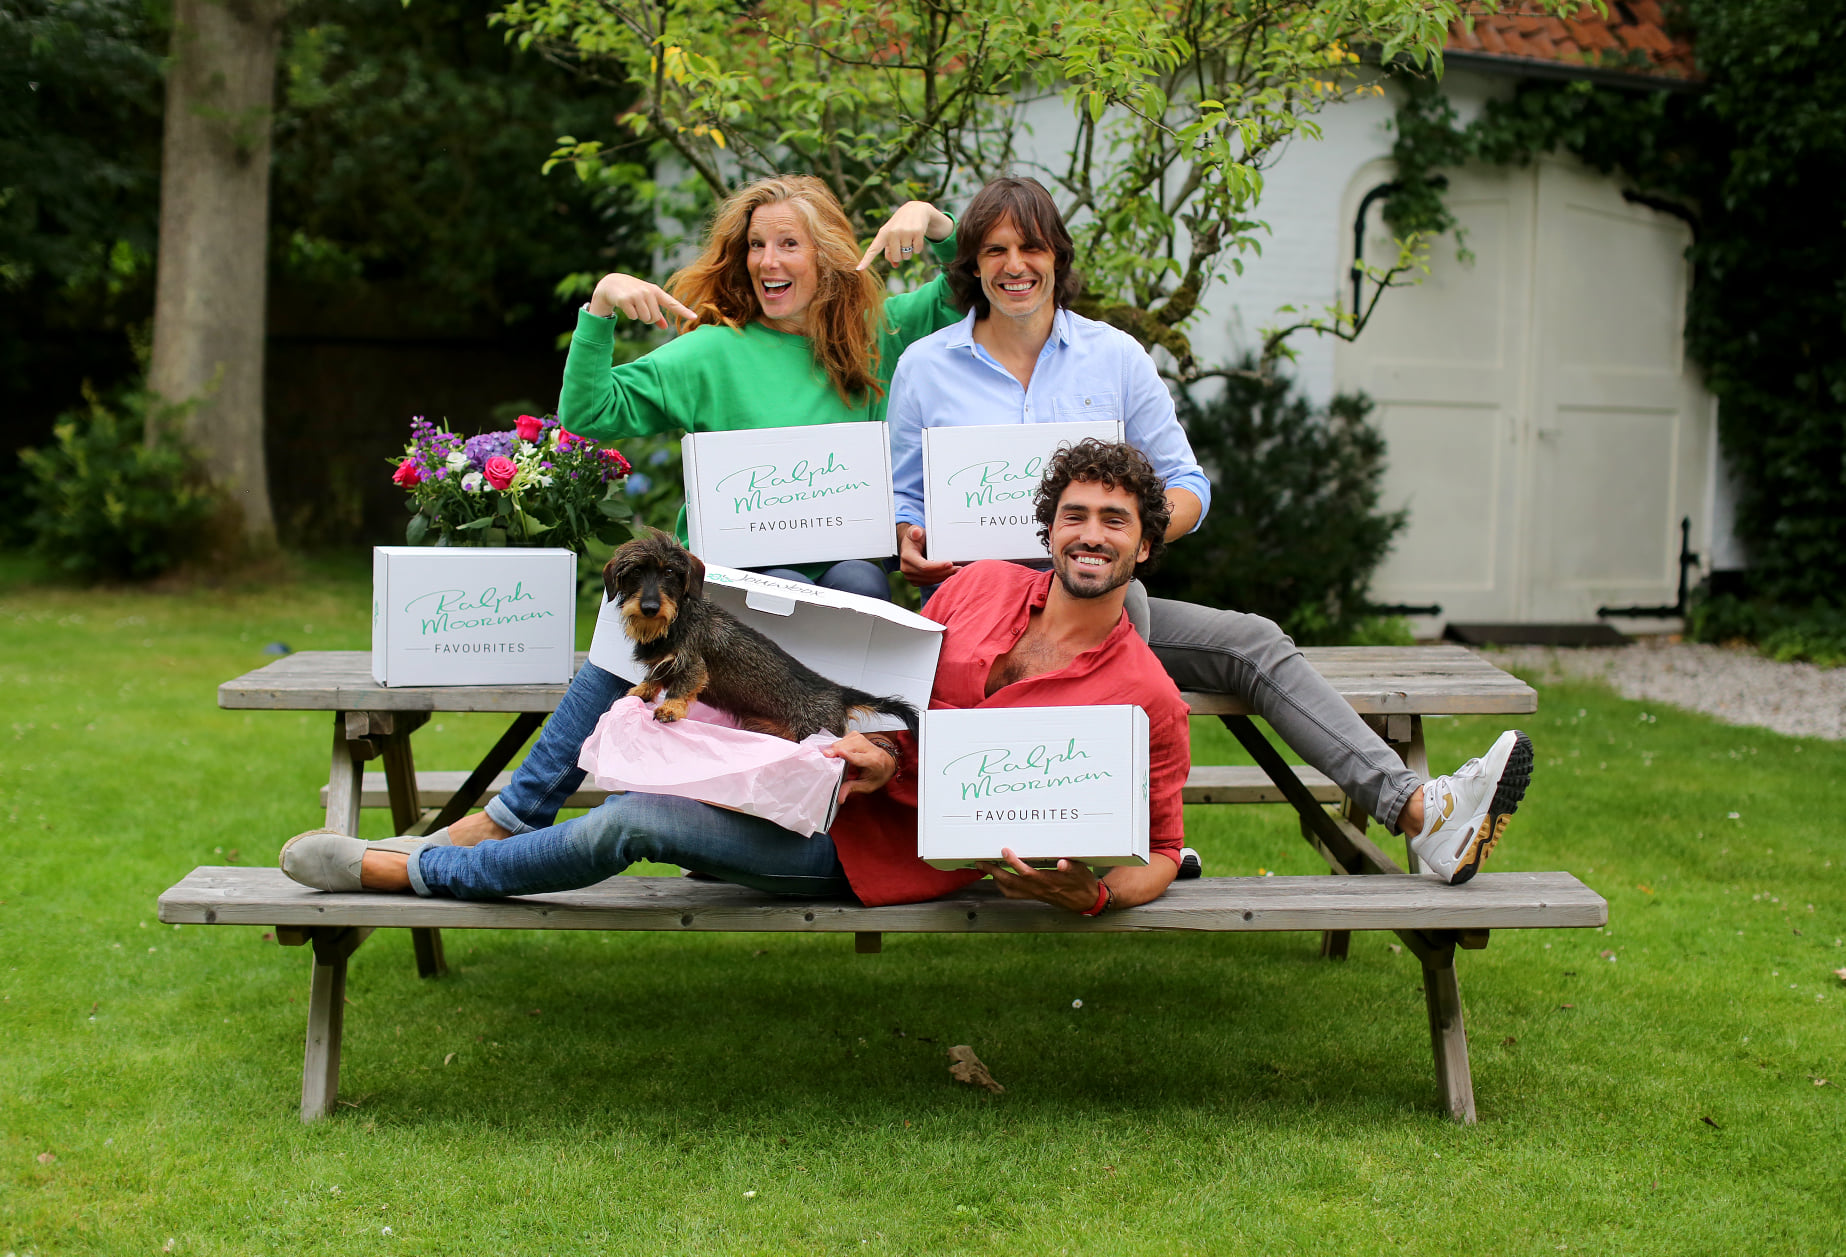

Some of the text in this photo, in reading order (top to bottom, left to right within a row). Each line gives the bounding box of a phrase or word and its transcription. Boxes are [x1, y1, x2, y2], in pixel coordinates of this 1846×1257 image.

[715, 452, 849, 492] Ralph
[947, 456, 1046, 487] Ral
[733, 481, 870, 514] Moorman
[965, 484, 1037, 508] Moor
[749, 516, 843, 532] FAVOURITES
[980, 514, 1040, 526] FAVOUR
[405, 581, 535, 615] Ralph
[421, 610, 554, 635] Moorman
[434, 642, 525, 653] FAVOURITES
[942, 737, 1092, 777] Ralph
[960, 771, 1113, 800] Moorman
[975, 808, 1080, 821] FAVOURITES
